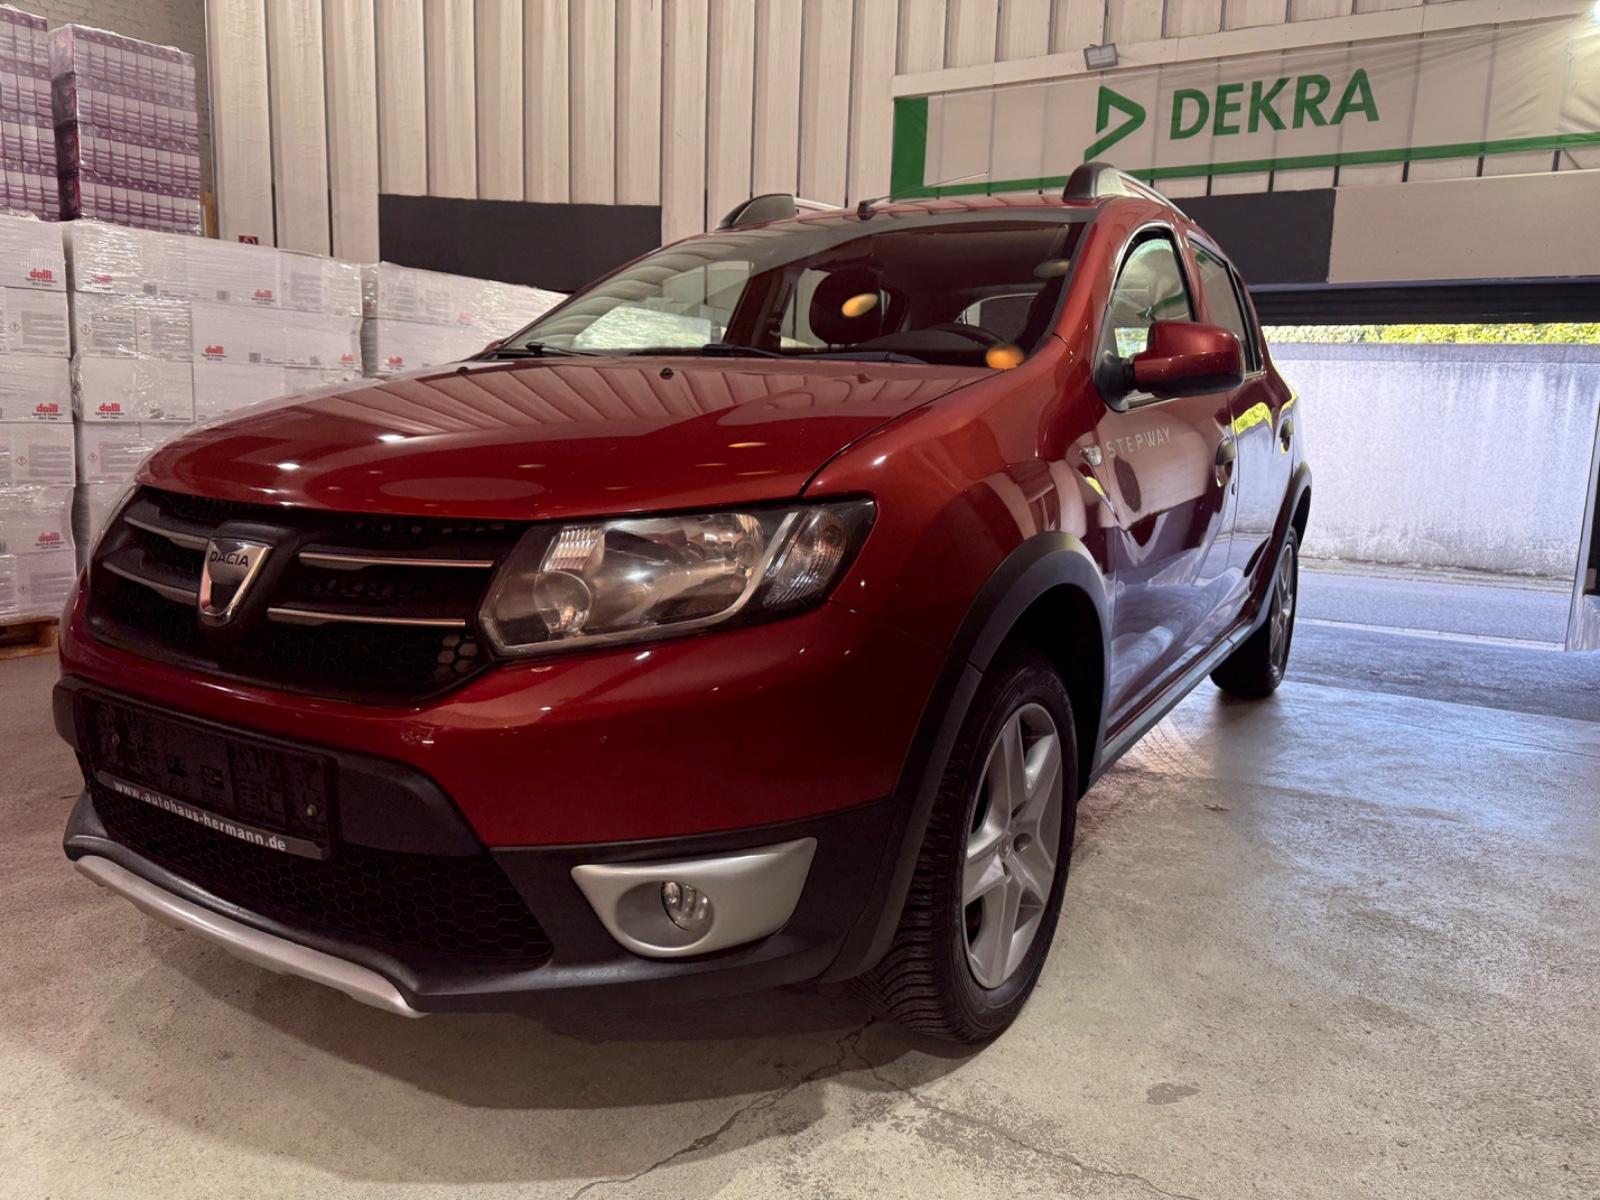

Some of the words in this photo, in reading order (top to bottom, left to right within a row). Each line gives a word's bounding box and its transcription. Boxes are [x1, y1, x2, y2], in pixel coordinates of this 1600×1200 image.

[1169, 67, 1380, 141] DEKRA
[36, 403, 58, 413] dalli
[99, 402, 120, 412] dalli
[1105, 426, 1170, 458] STEPWAY
[209, 550, 249, 567] DACIA
[113, 780, 287, 852] www.autohaus-hermann.de
